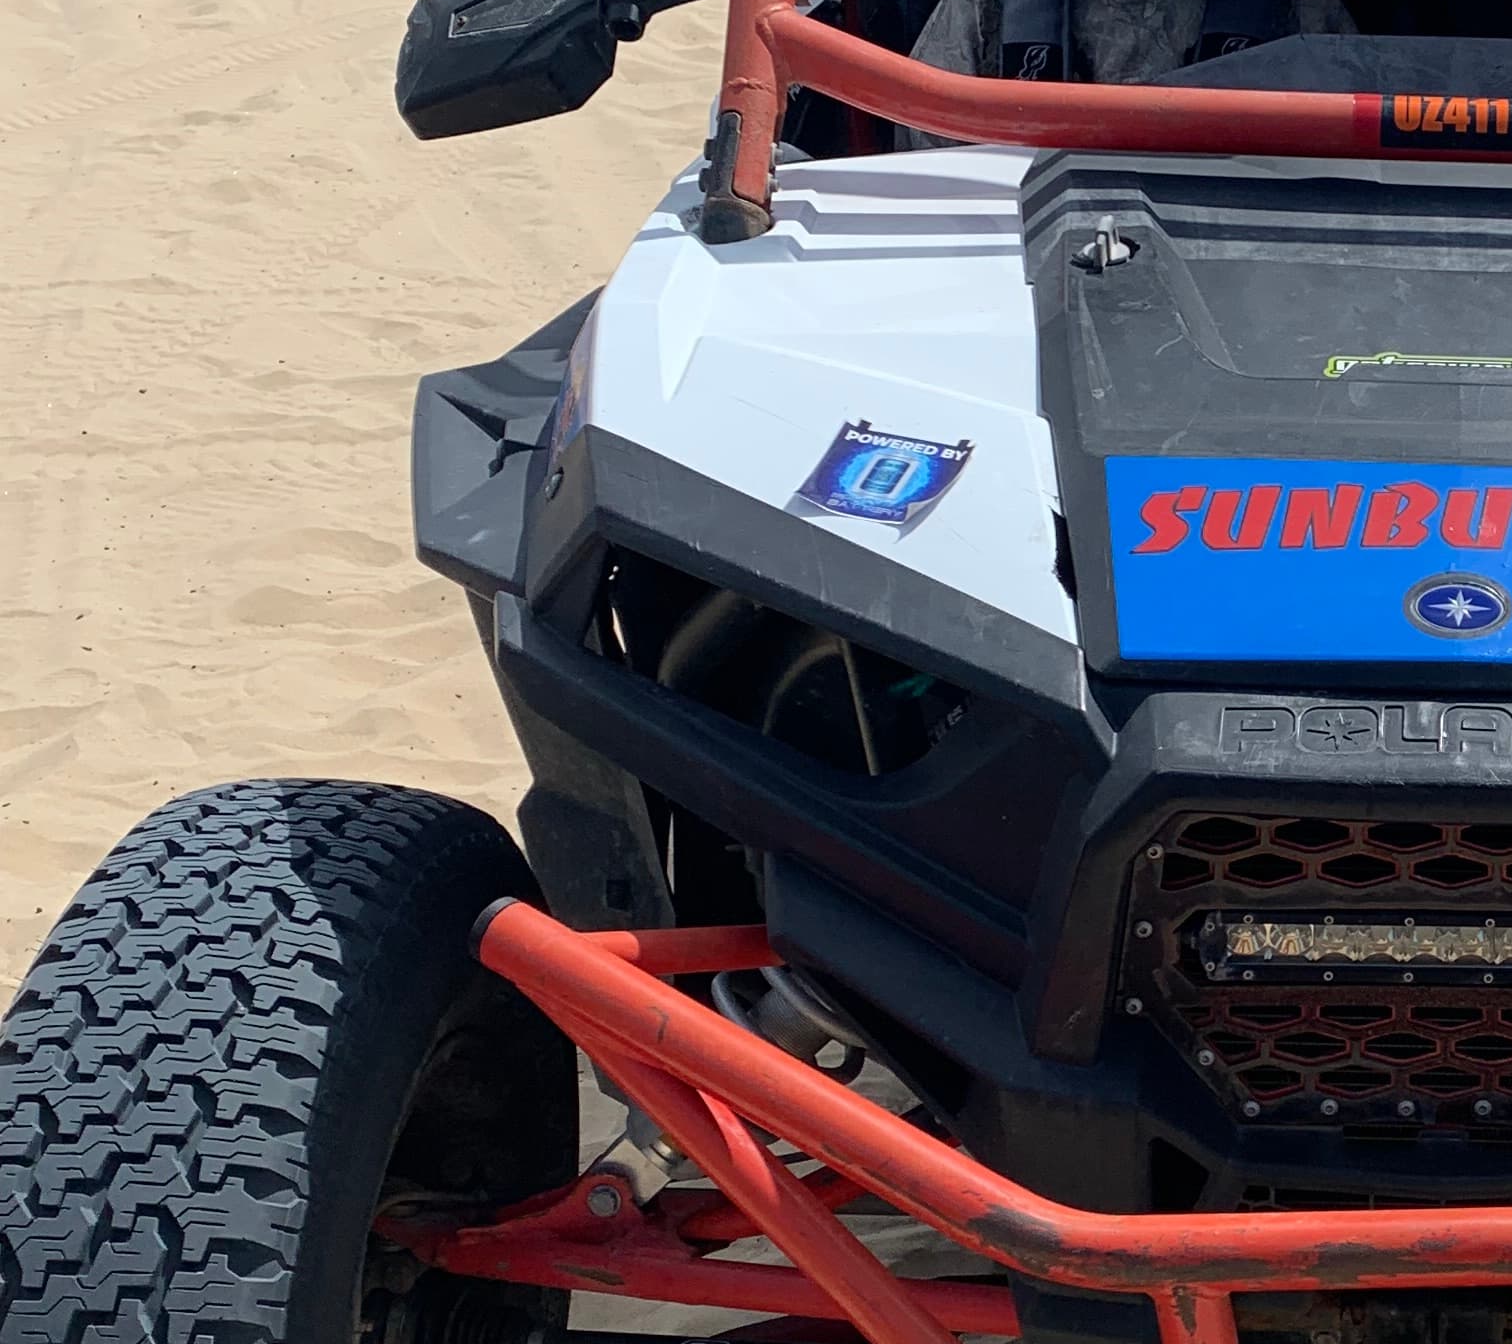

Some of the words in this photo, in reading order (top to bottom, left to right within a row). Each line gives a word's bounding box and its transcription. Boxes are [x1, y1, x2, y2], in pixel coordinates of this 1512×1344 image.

[1394, 95, 1510, 134] UZ411
[845, 429, 939, 456] POWERED
[939, 447, 969, 462] BY
